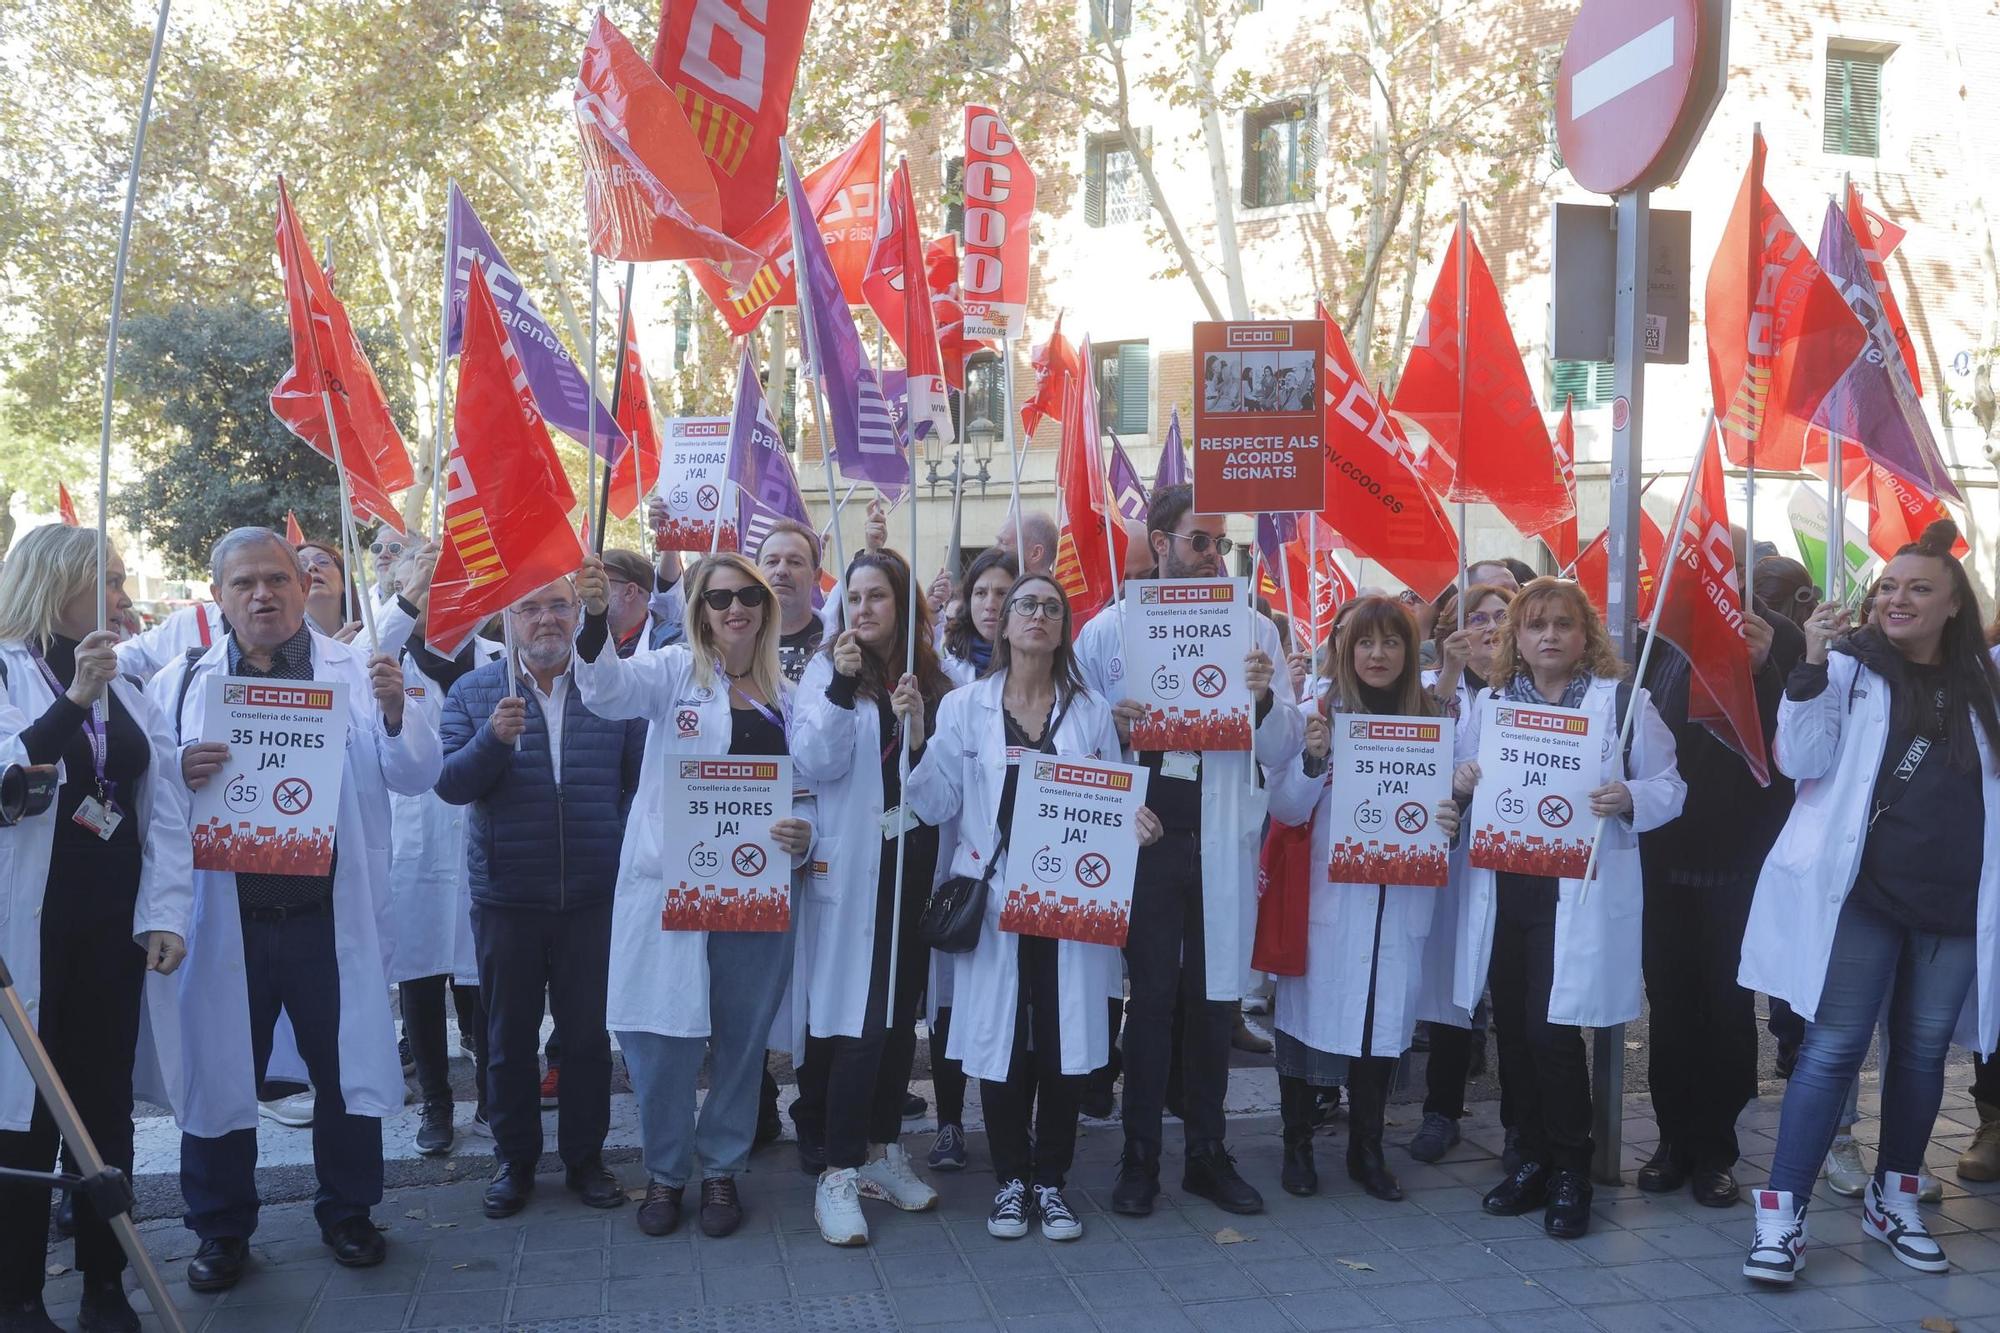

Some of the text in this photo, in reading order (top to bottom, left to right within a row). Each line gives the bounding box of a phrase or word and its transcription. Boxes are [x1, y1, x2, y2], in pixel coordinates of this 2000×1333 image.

[962, 114, 1014, 294] CCOO
[1232, 331, 1273, 342] CCOO
[686, 425, 717, 435] CCOO
[1200, 435, 1319, 451] RESPECTE ALS
[673, 453, 726, 464] 35 HORAS
[1225, 451, 1294, 465] ACORDS
[685, 468, 707, 480] ¡YA!
[1222, 466, 1297, 480] SIGNATS!
[672, 491, 689, 504] 35
[1163, 588, 1210, 600] CCOO
[1148, 624, 1232, 639] 35 HORAS
[1172, 644, 1204, 660] ¡YA!
[1157, 674, 1179, 690] 35
[250, 689, 306, 705] CCOO
[231, 710, 323, 723] Conselleria de Sanitat
[1517, 713, 1564, 730] CCOO
[230, 729, 325, 748] 35 HORES
[1371, 725, 1418, 738] CCOO
[1501, 731, 1580, 748] Conselleria de Sanitat
[1354, 743, 1435, 754] Conselleria de Sanidad
[257, 752, 286, 771] JA!
[1500, 747, 1582, 771] 35 HORES
[703, 764, 754, 777] CCOO
[1058, 767, 1108, 785] CCOO
[1355, 760, 1437, 776] 35 HORAS
[1521, 770, 1547, 787] JA!
[230, 785, 257, 802] 35
[687, 784, 770, 793] Conselleria de Sanitat
[1039, 786, 1122, 804] Conselleria de Sanitat
[1377, 780, 1409, 796] ¡YA!
[688, 800, 773, 816] 35 HORES
[1501, 797, 1524, 815] 35
[1038, 803, 1123, 827] 35 HORES
[1359, 808, 1382, 824] 35
[714, 821, 740, 838] JA!
[1061, 827, 1088, 844] JA!
[694, 851, 718, 867] 35
[1037, 855, 1062, 873] 35
